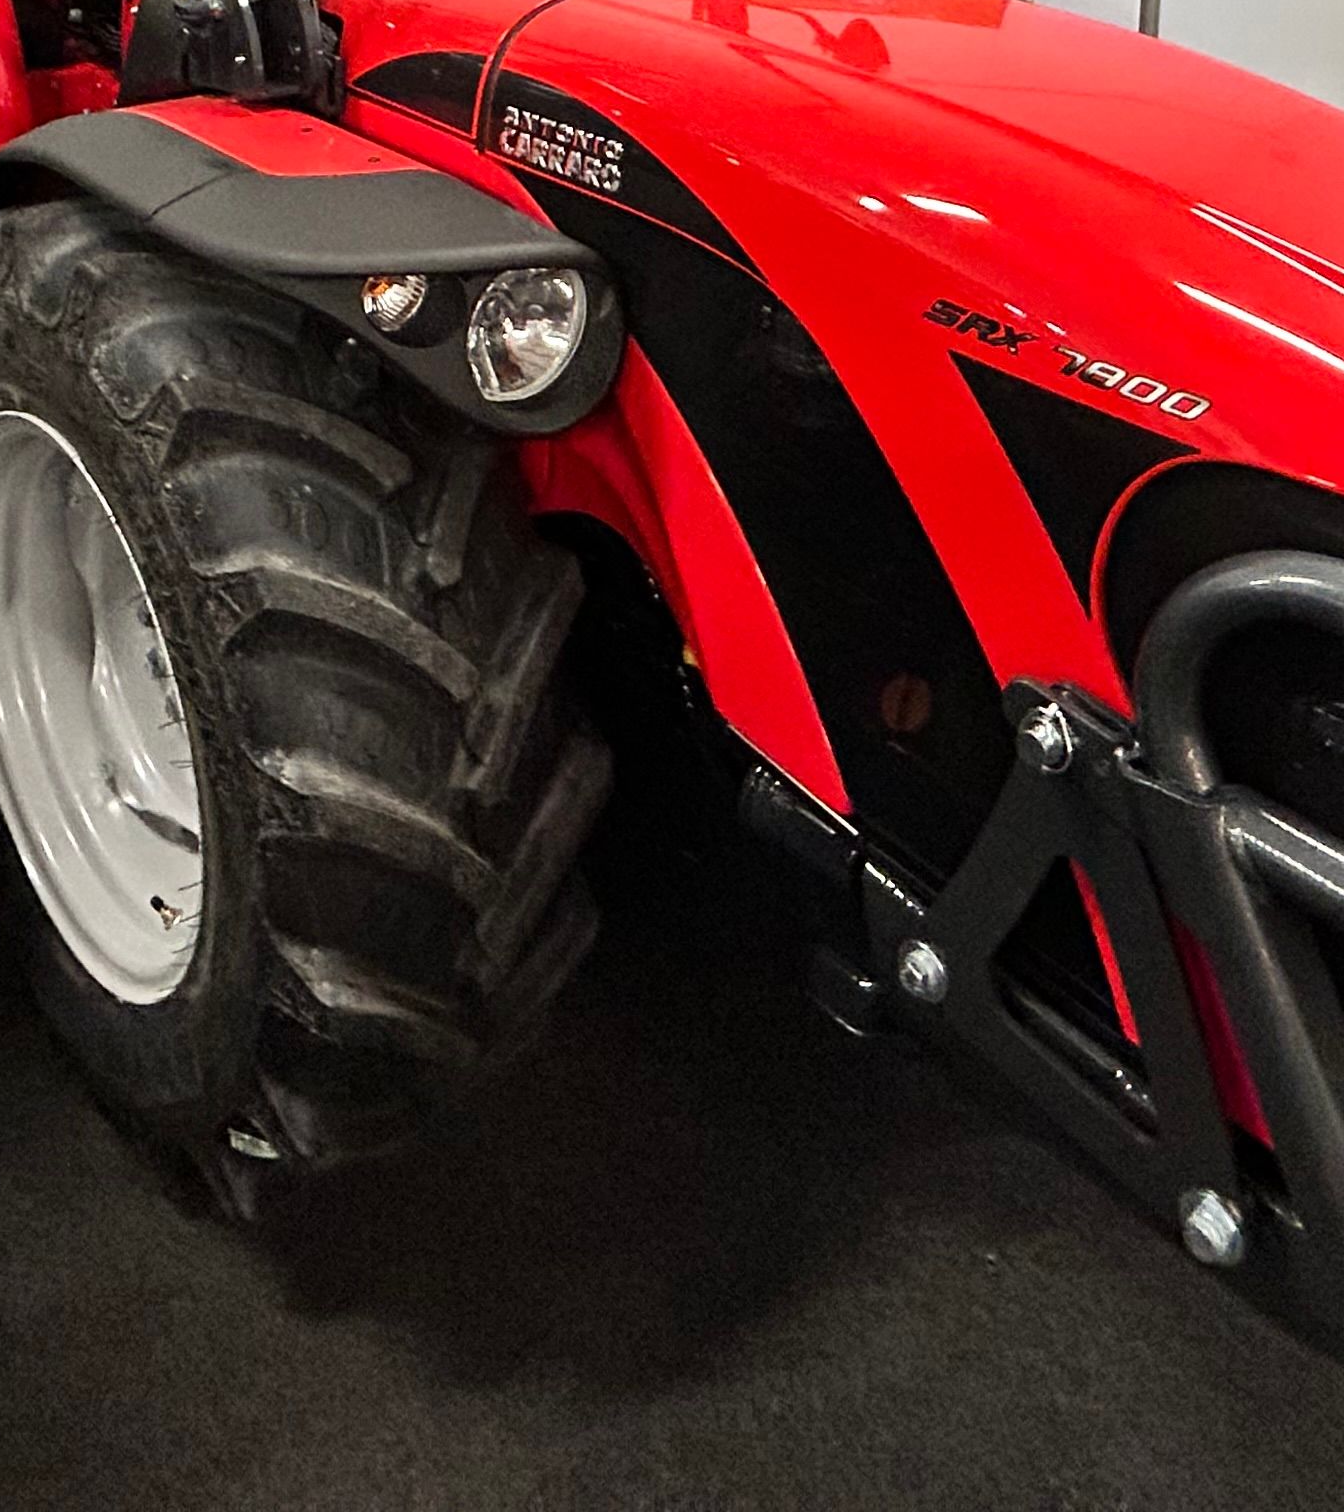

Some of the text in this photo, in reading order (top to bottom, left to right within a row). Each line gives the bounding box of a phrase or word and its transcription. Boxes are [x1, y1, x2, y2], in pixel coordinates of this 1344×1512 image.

[498, 126, 622, 192] CARRARO
[503, 105, 625, 161] ANTONIO
[921, 296, 1039, 356] SRX
